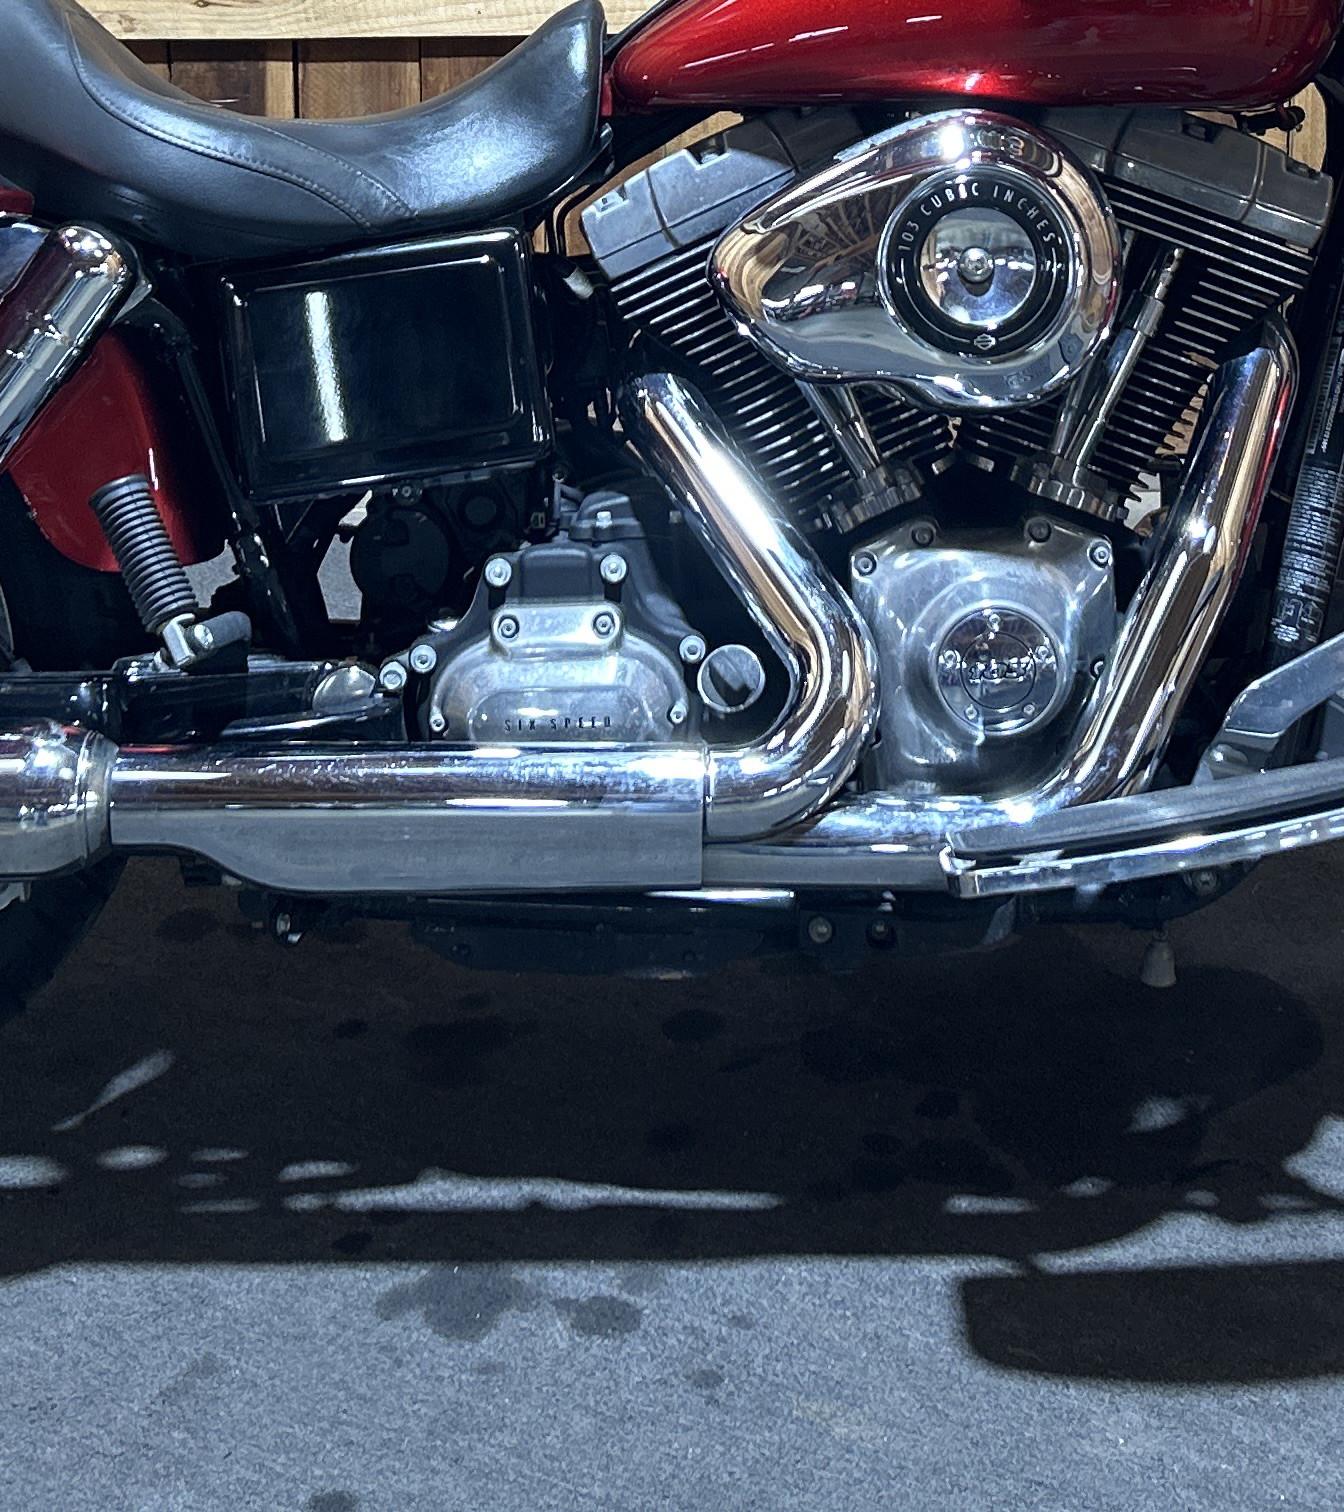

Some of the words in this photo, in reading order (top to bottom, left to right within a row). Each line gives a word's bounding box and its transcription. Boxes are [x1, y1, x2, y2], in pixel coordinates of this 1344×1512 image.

[898, 221, 919, 251] 103
[920, 182, 980, 216] CUBIC
[993, 185, 1056, 243] INCHES
[505, 719, 536, 731] SIX
[550, 716, 611, 729] SPEED
